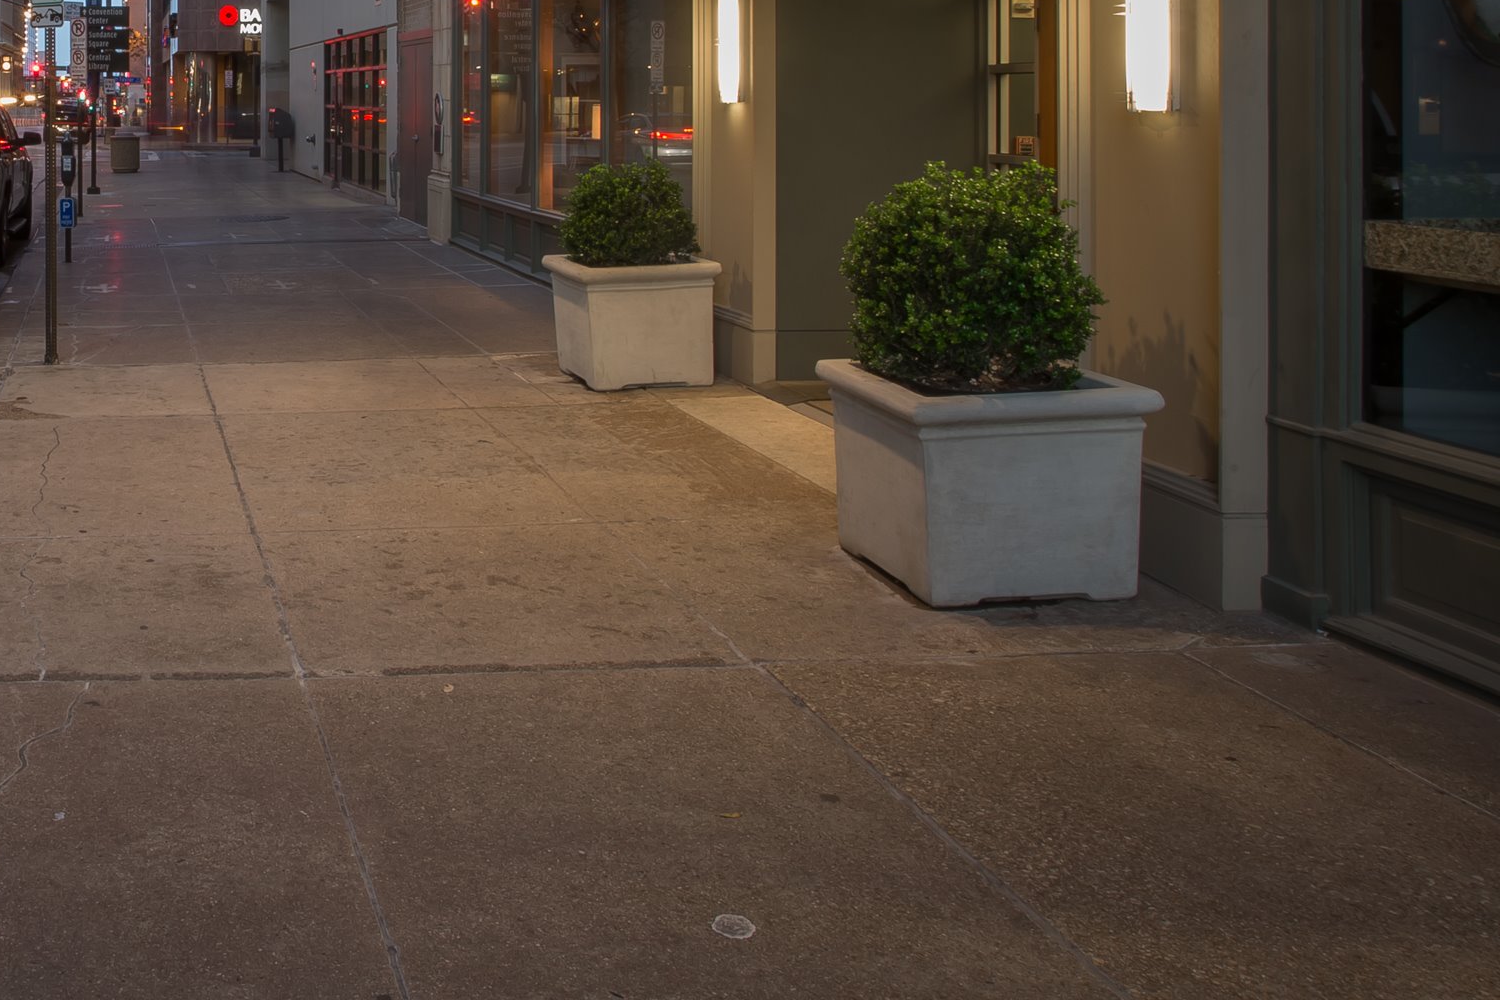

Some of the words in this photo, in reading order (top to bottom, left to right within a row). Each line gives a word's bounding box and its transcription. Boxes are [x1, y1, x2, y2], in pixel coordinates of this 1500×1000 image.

[88, 8, 123, 16] Convention
[88, 17, 109, 25] Center
[88, 31, 118, 39] Sundance
[88, 40, 110, 48] Square
[88, 54, 111, 62] Central
[88, 63, 110, 71] Library
[62, 201, 71, 213] P
